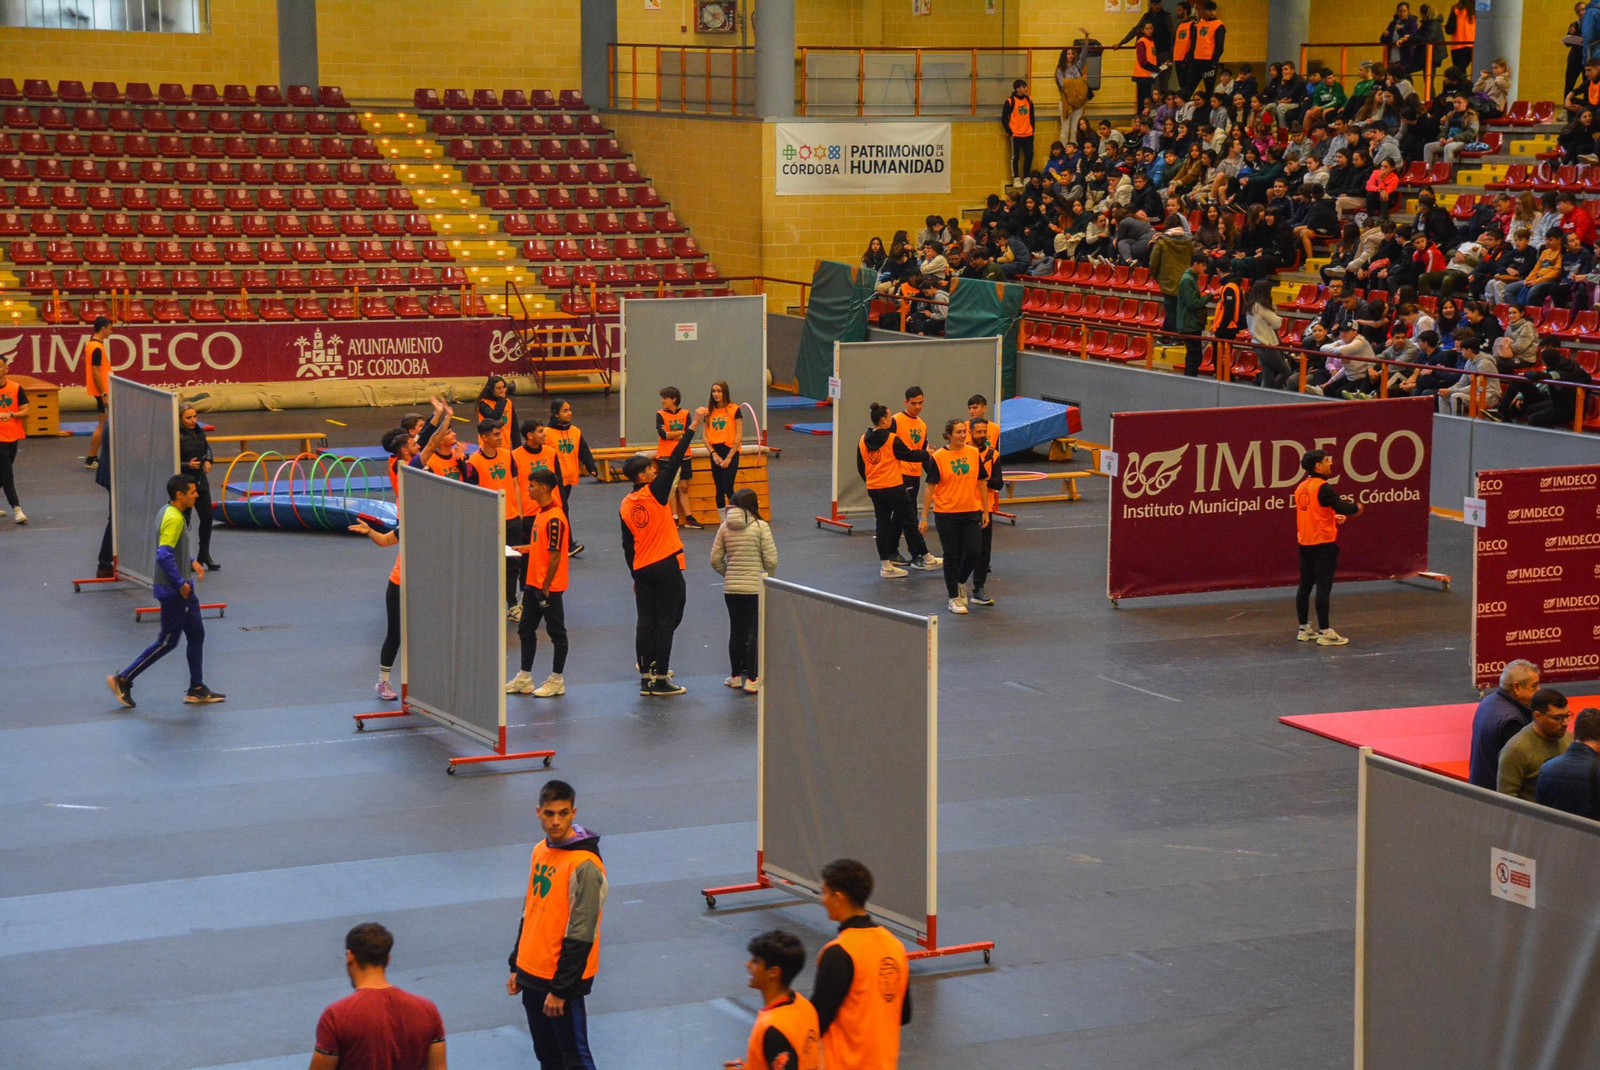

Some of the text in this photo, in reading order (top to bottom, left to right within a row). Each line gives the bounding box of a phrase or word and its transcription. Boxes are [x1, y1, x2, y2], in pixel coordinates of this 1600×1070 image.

[850, 144, 935, 158] PATRIMONIO
[782, 161, 840, 175] CÓRDOBA
[850, 159, 944, 175] HUMANIDAD
[30, 331, 243, 373] IMDECO
[347, 336, 443, 355] AYUNTAMIENTO
[348, 356, 430, 376] DE CÓRDOBA
[1194, 429, 1425, 493] IMDECO
[1552, 473, 1597, 487] IMDECO
[1122, 502, 1185, 519] Instituto
[1188, 496, 1261, 515] Municipal
[1265, 495, 1284, 510] de
[1359, 486, 1420, 504] Córdoba
[1520, 505, 1565, 519] IMDECO
[1478, 539, 1508, 551] DECO
[1557, 533, 1600, 546] IMDECO
[1519, 565, 1563, 579] IMDECO
[1477, 601, 1507, 614] DECO
[1556, 594, 1600, 608] IMDECO
[1518, 627, 1562, 640] IMDECO
[1477, 661, 1506, 673] DECO
[1555, 654, 1599, 668] IMDECO
